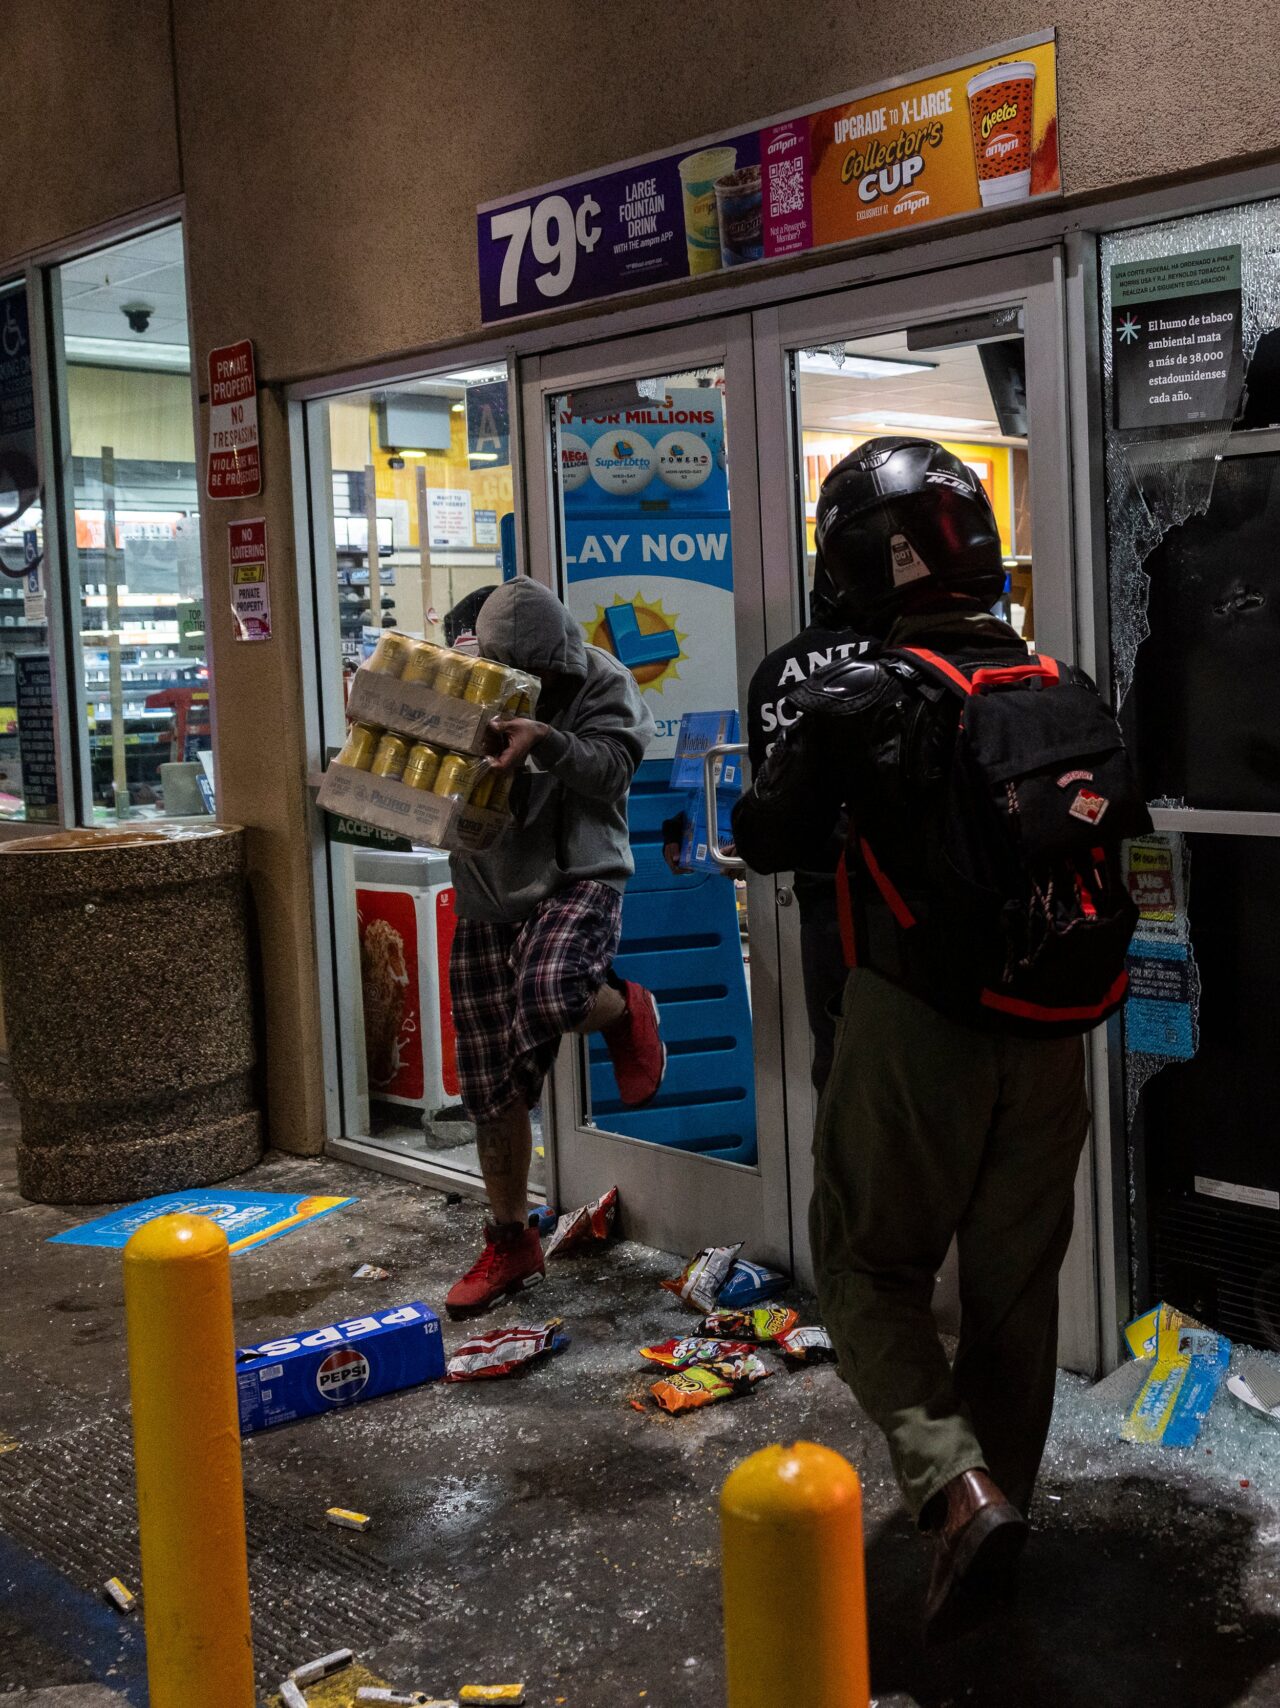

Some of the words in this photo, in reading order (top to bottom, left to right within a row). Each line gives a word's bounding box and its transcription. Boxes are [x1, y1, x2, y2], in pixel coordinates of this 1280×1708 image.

[833, 107, 888, 145] UPGRADE
[889, 108, 899, 126] TO
[900, 87, 953, 126] X-LARGE
[980, 101, 1018, 140] Cheetos
[767, 136, 797, 155] ampm
[841, 120, 944, 184] Collector's
[985, 136, 1019, 158] ampm
[857, 155, 925, 203] CUP
[625, 177, 657, 203] LARGE
[619, 193, 665, 223] FOUNTAIN
[893, 194, 930, 215] ampm
[627, 214, 657, 239] DRINK
[490, 194, 602, 307] 79¢
[613, 242, 628, 254] WITH
[628, 239, 640, 250] THE
[660, 231, 674, 242] APP
[1148, 320, 1158, 332] El
[1159, 319, 1187, 330] humo
[1188, 315, 1200, 326] de
[1201, 312, 1234, 324] tabaco
[1148, 333, 1196, 350] ambiental
[1196, 332, 1222, 344] mata
[217, 354, 249, 380] PRIVATE
[1148, 360, 1154, 368] a
[1155, 354, 1175, 367] más
[1176, 353, 1188, 365] de
[1189, 351, 1224, 364] 38,000
[213, 374, 253, 401] PROPERTY
[1148, 369, 1226, 386] estadounidenses
[1149, 392, 1171, 404] cada
[1172, 390, 1192, 401] año.
[231, 405, 244, 426] NO
[625, 410, 716, 424] MILLIONS
[213, 424, 257, 448] TRESPASSING
[211, 473, 222, 486] BE
[925, 475, 972, 494] HJC
[241, 528, 253, 541] NO
[232, 543, 265, 560] LOITERING
[641, 533, 729, 562] NOW
[238, 587, 260, 600] PRIVATE
[188, 609, 202, 620] TOP
[236, 600, 264, 612] PROPERTY
[319, 1364, 368, 1387] PEPSI
